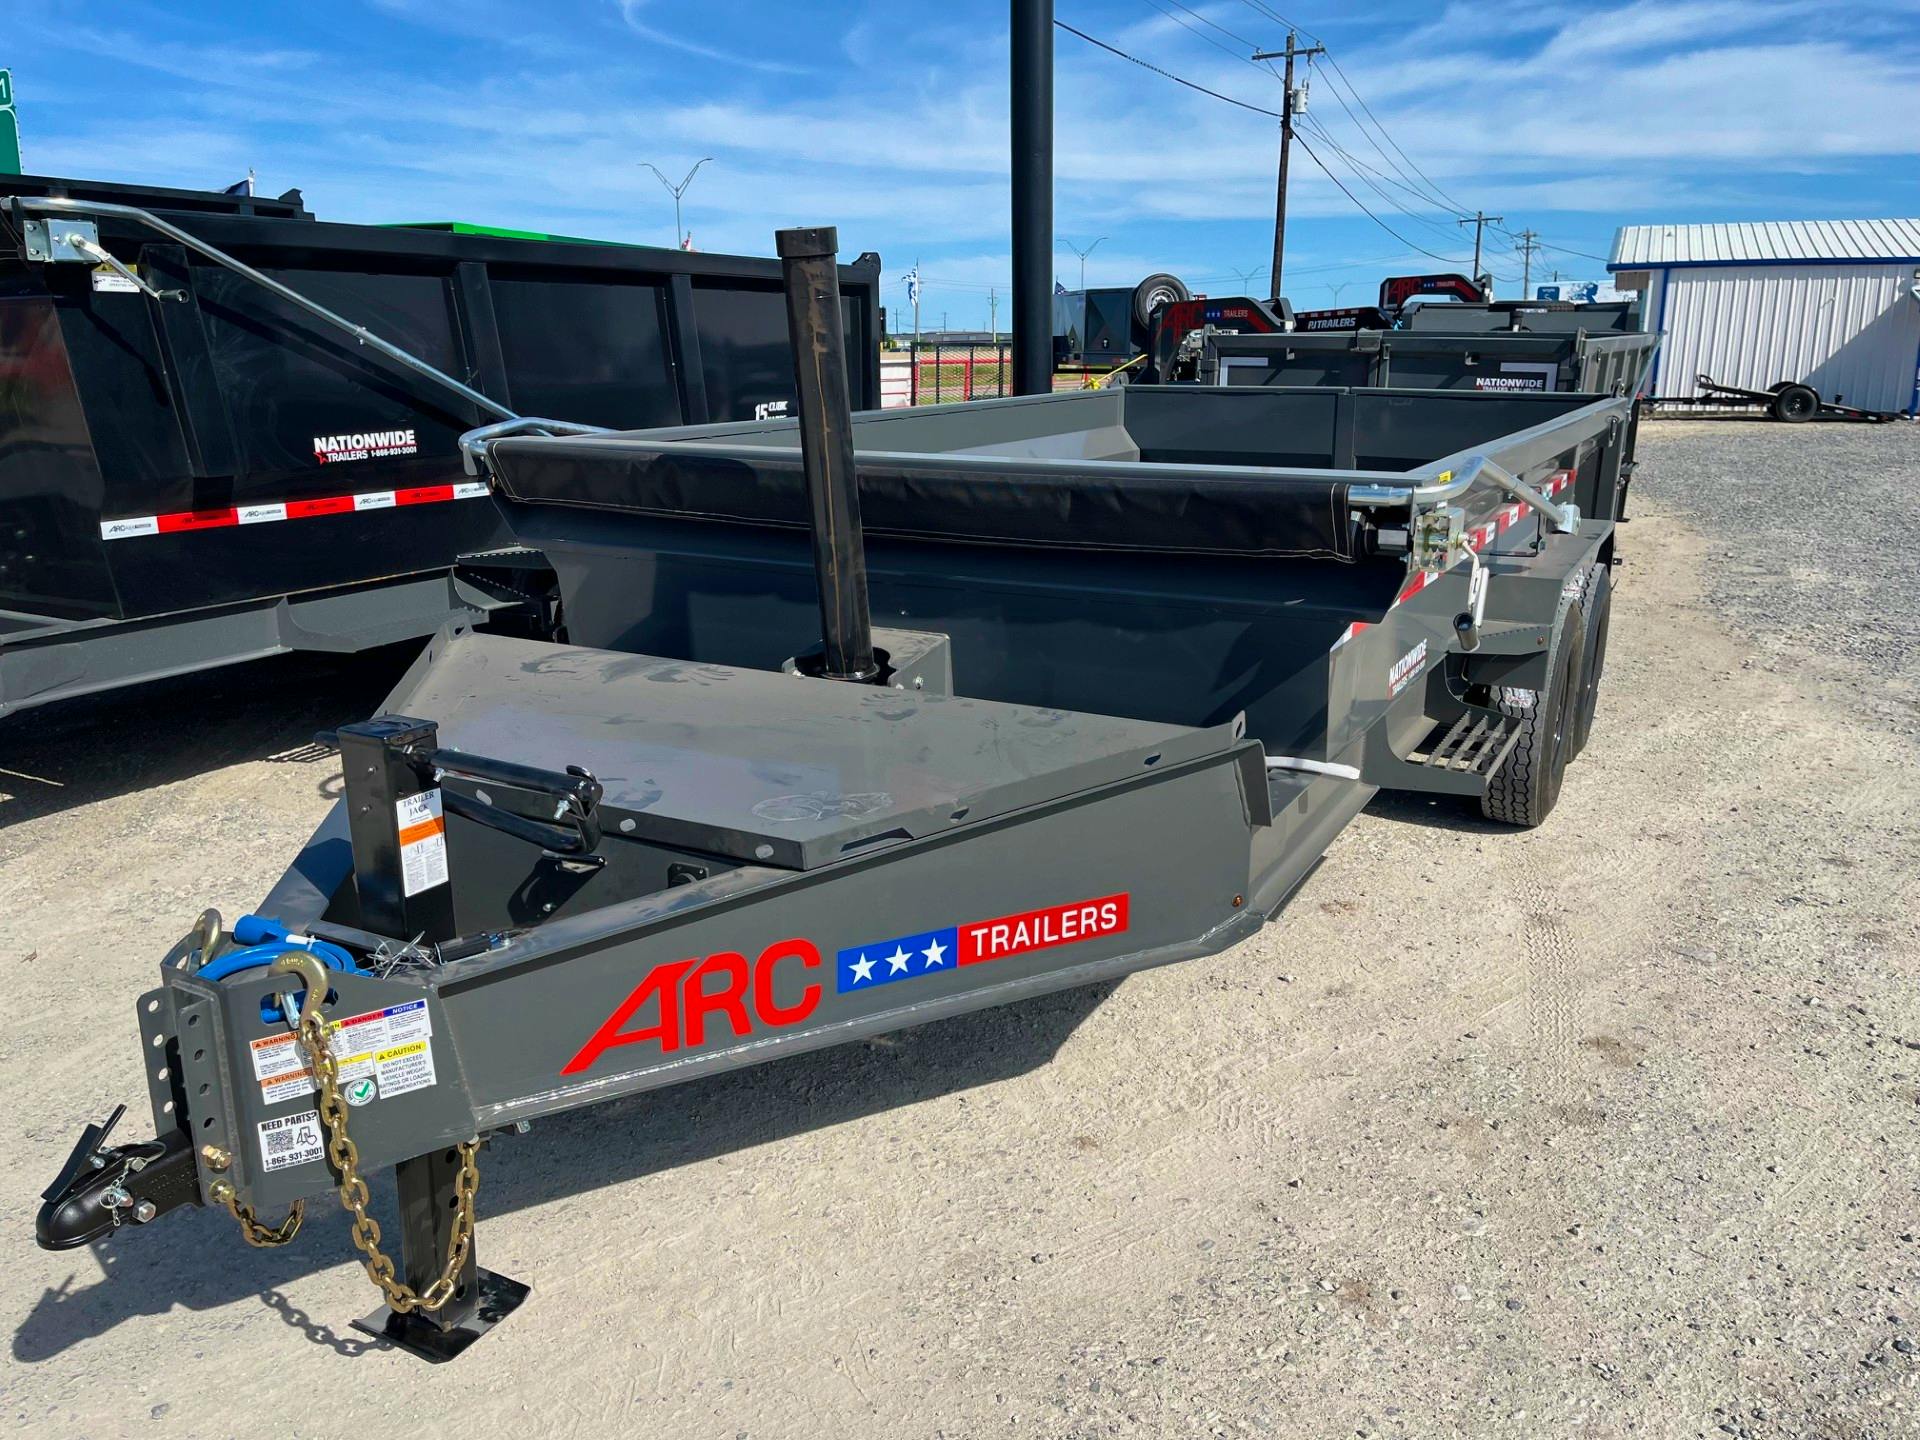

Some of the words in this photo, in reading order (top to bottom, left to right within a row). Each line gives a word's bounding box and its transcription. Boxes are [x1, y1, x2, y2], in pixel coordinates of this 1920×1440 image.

[1223, 309, 1249, 318] TRAILERS
[1476, 377, 1543, 388] NATIONWIDE
[755, 403, 769, 420] 15
[313, 430, 416, 452] NATIONWIDE
[326, 450, 369, 462] TRAILERS
[1389, 638, 1427, 687] NATIONWIDE
[403, 791, 434, 808] TRAILER
[408, 803, 430, 817] JACK
[970, 902, 1118, 957] TRAILERS
[392, 1003, 418, 1014] NOTICE
[559, 937, 823, 1076] ARC
[352, 1012, 383, 1024] DANGER
[263, 1032, 297, 1046] WARNING
[387, 1044, 422, 1058] CAUTION
[401, 1054, 423, 1065] EXCEED
[274, 1069, 309, 1083] WARNING
[384, 1072, 405, 1081] VEHICLE
[406, 1066, 426, 1076] WEIGHT
[410, 1070, 433, 1081] LOADING
[261, 1119, 283, 1132] NEED
[285, 1112, 317, 1127] PARTS?
[265, 1147, 322, 1166] 1-866-931-3001
